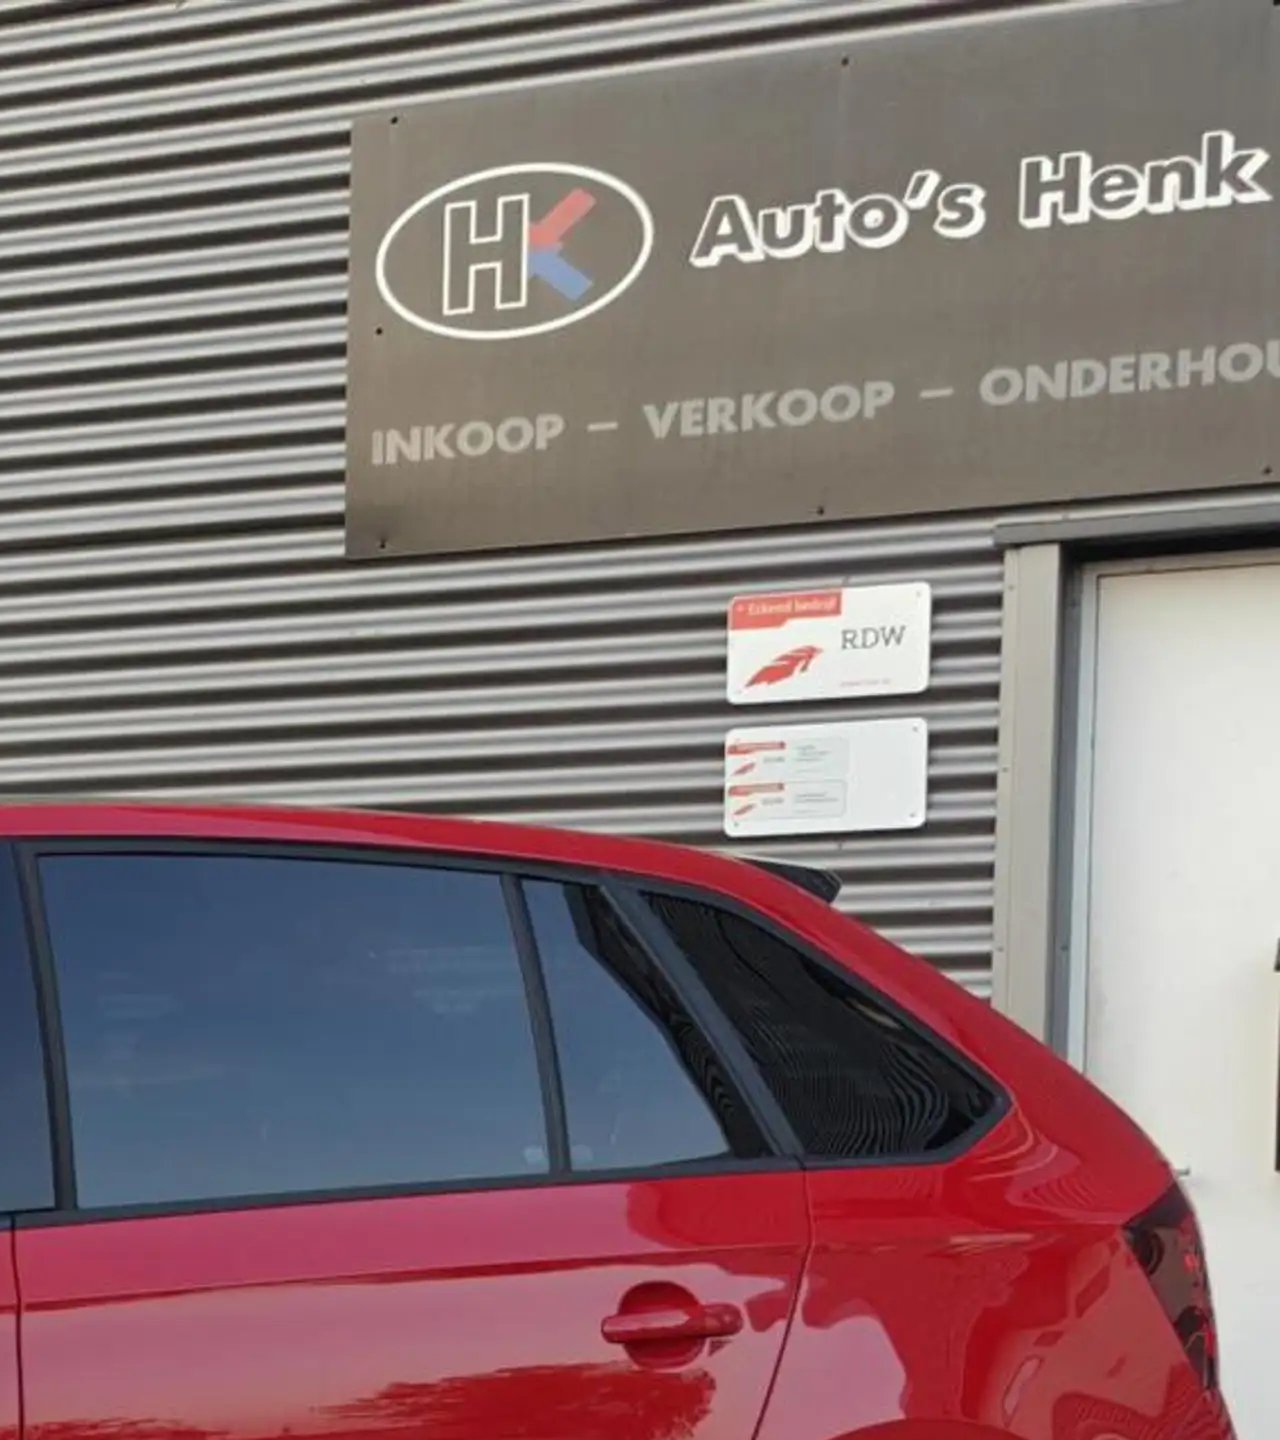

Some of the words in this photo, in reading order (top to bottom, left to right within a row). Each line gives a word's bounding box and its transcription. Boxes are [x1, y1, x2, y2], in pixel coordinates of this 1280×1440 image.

[689, 169, 987, 268] Auto's
[1018, 130, 1274, 229] Henk
[371, 412, 566, 465] INKOOP
[643, 380, 895, 439] VERKOOP
[841, 625, 907, 650] RDW
